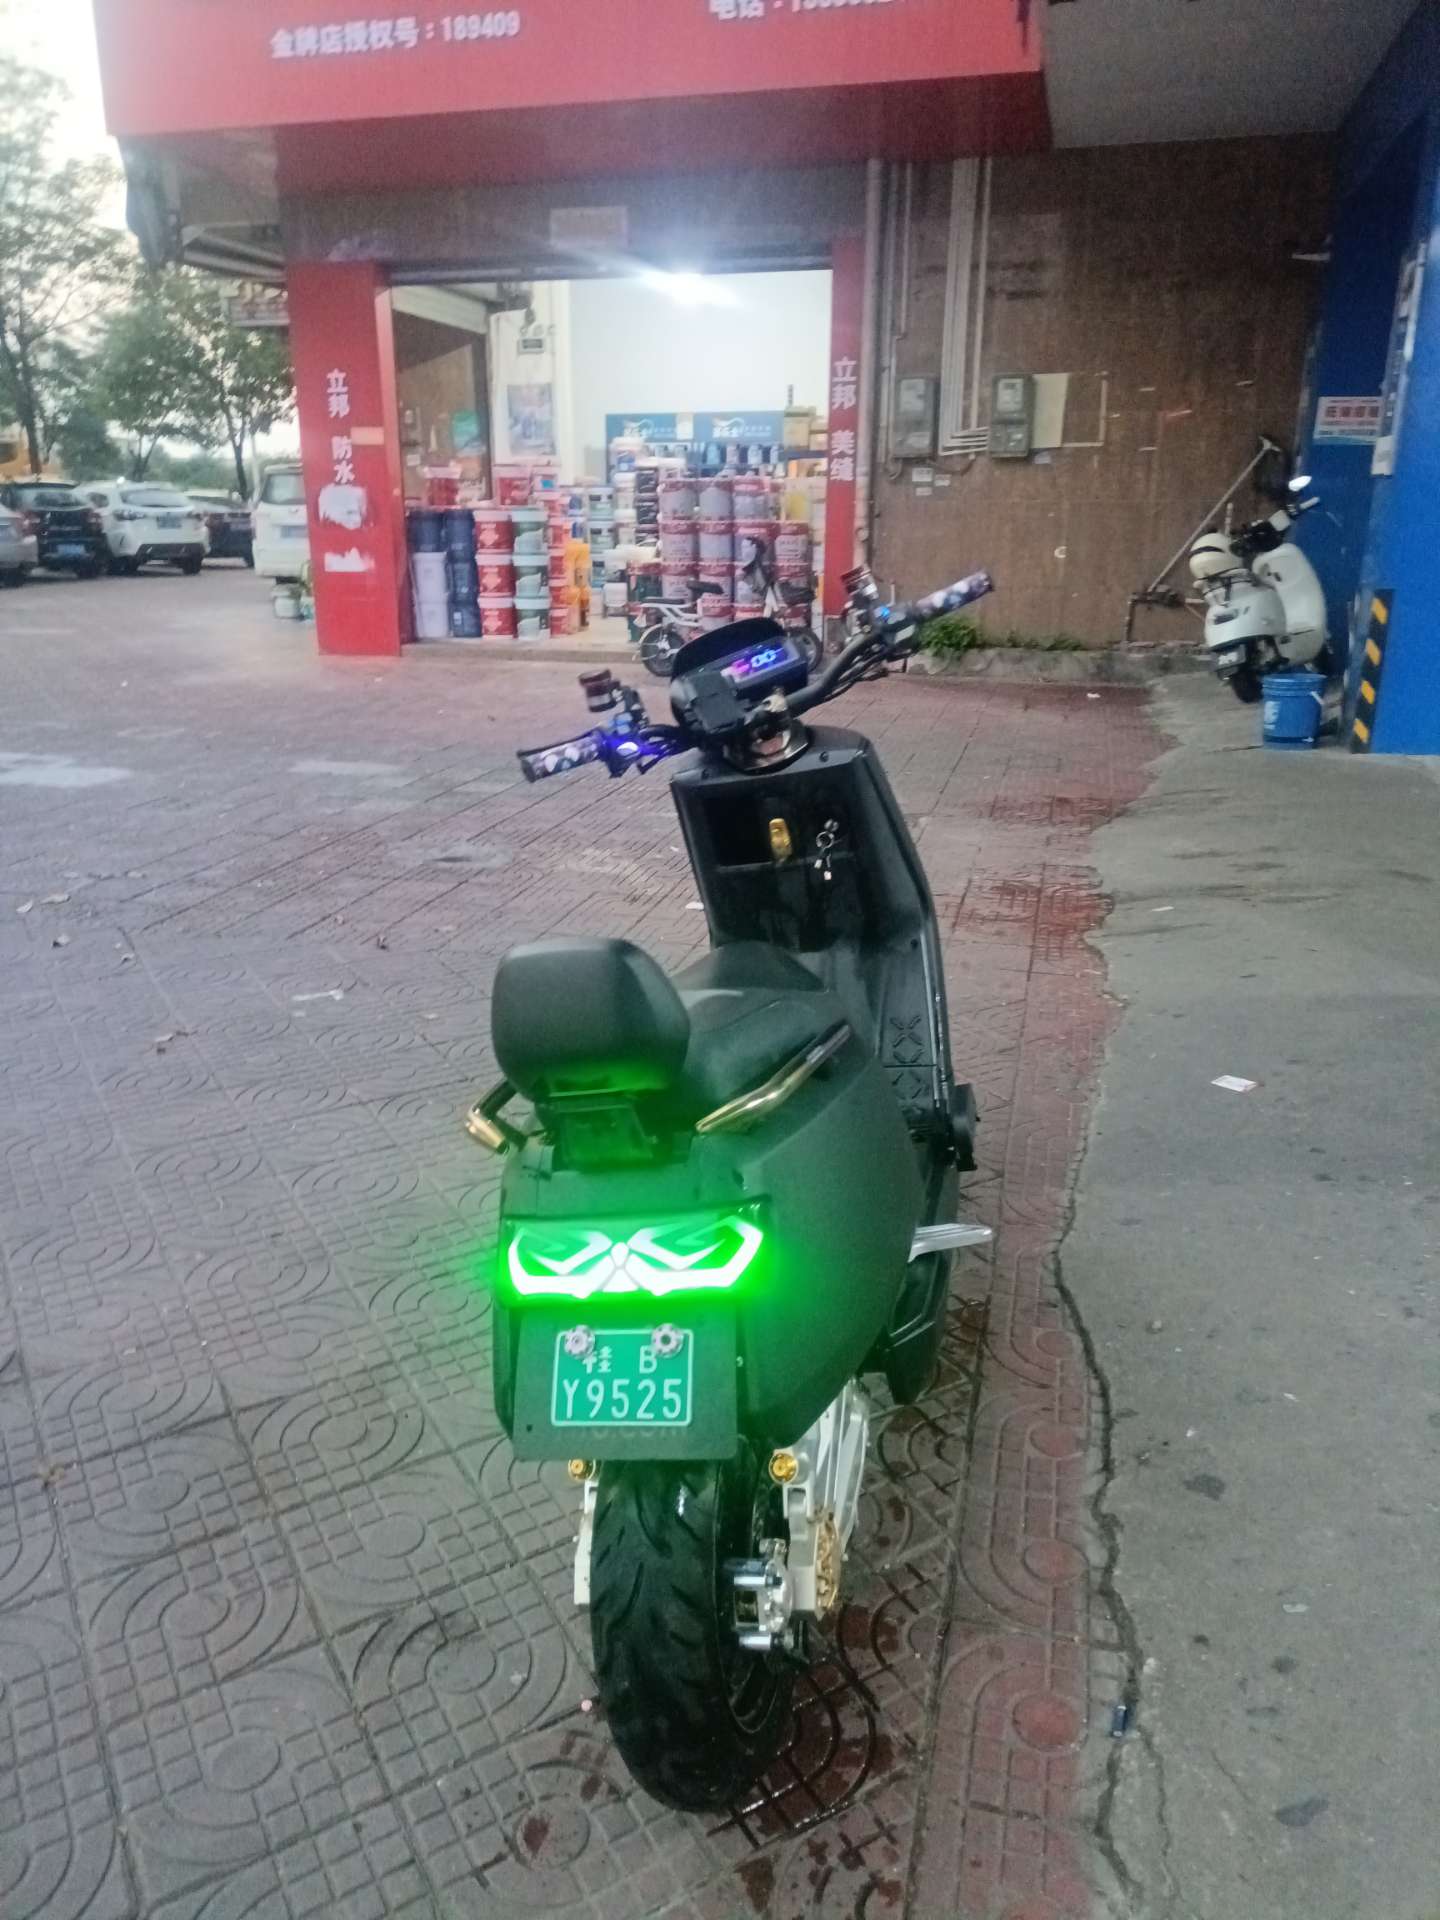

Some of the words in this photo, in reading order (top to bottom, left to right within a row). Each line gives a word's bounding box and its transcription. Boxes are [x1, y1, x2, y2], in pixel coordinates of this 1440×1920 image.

[331, 436, 355, 484] 防水
[638, 1345, 658, 1374] B
[562, 1378, 682, 1420] Y9525
